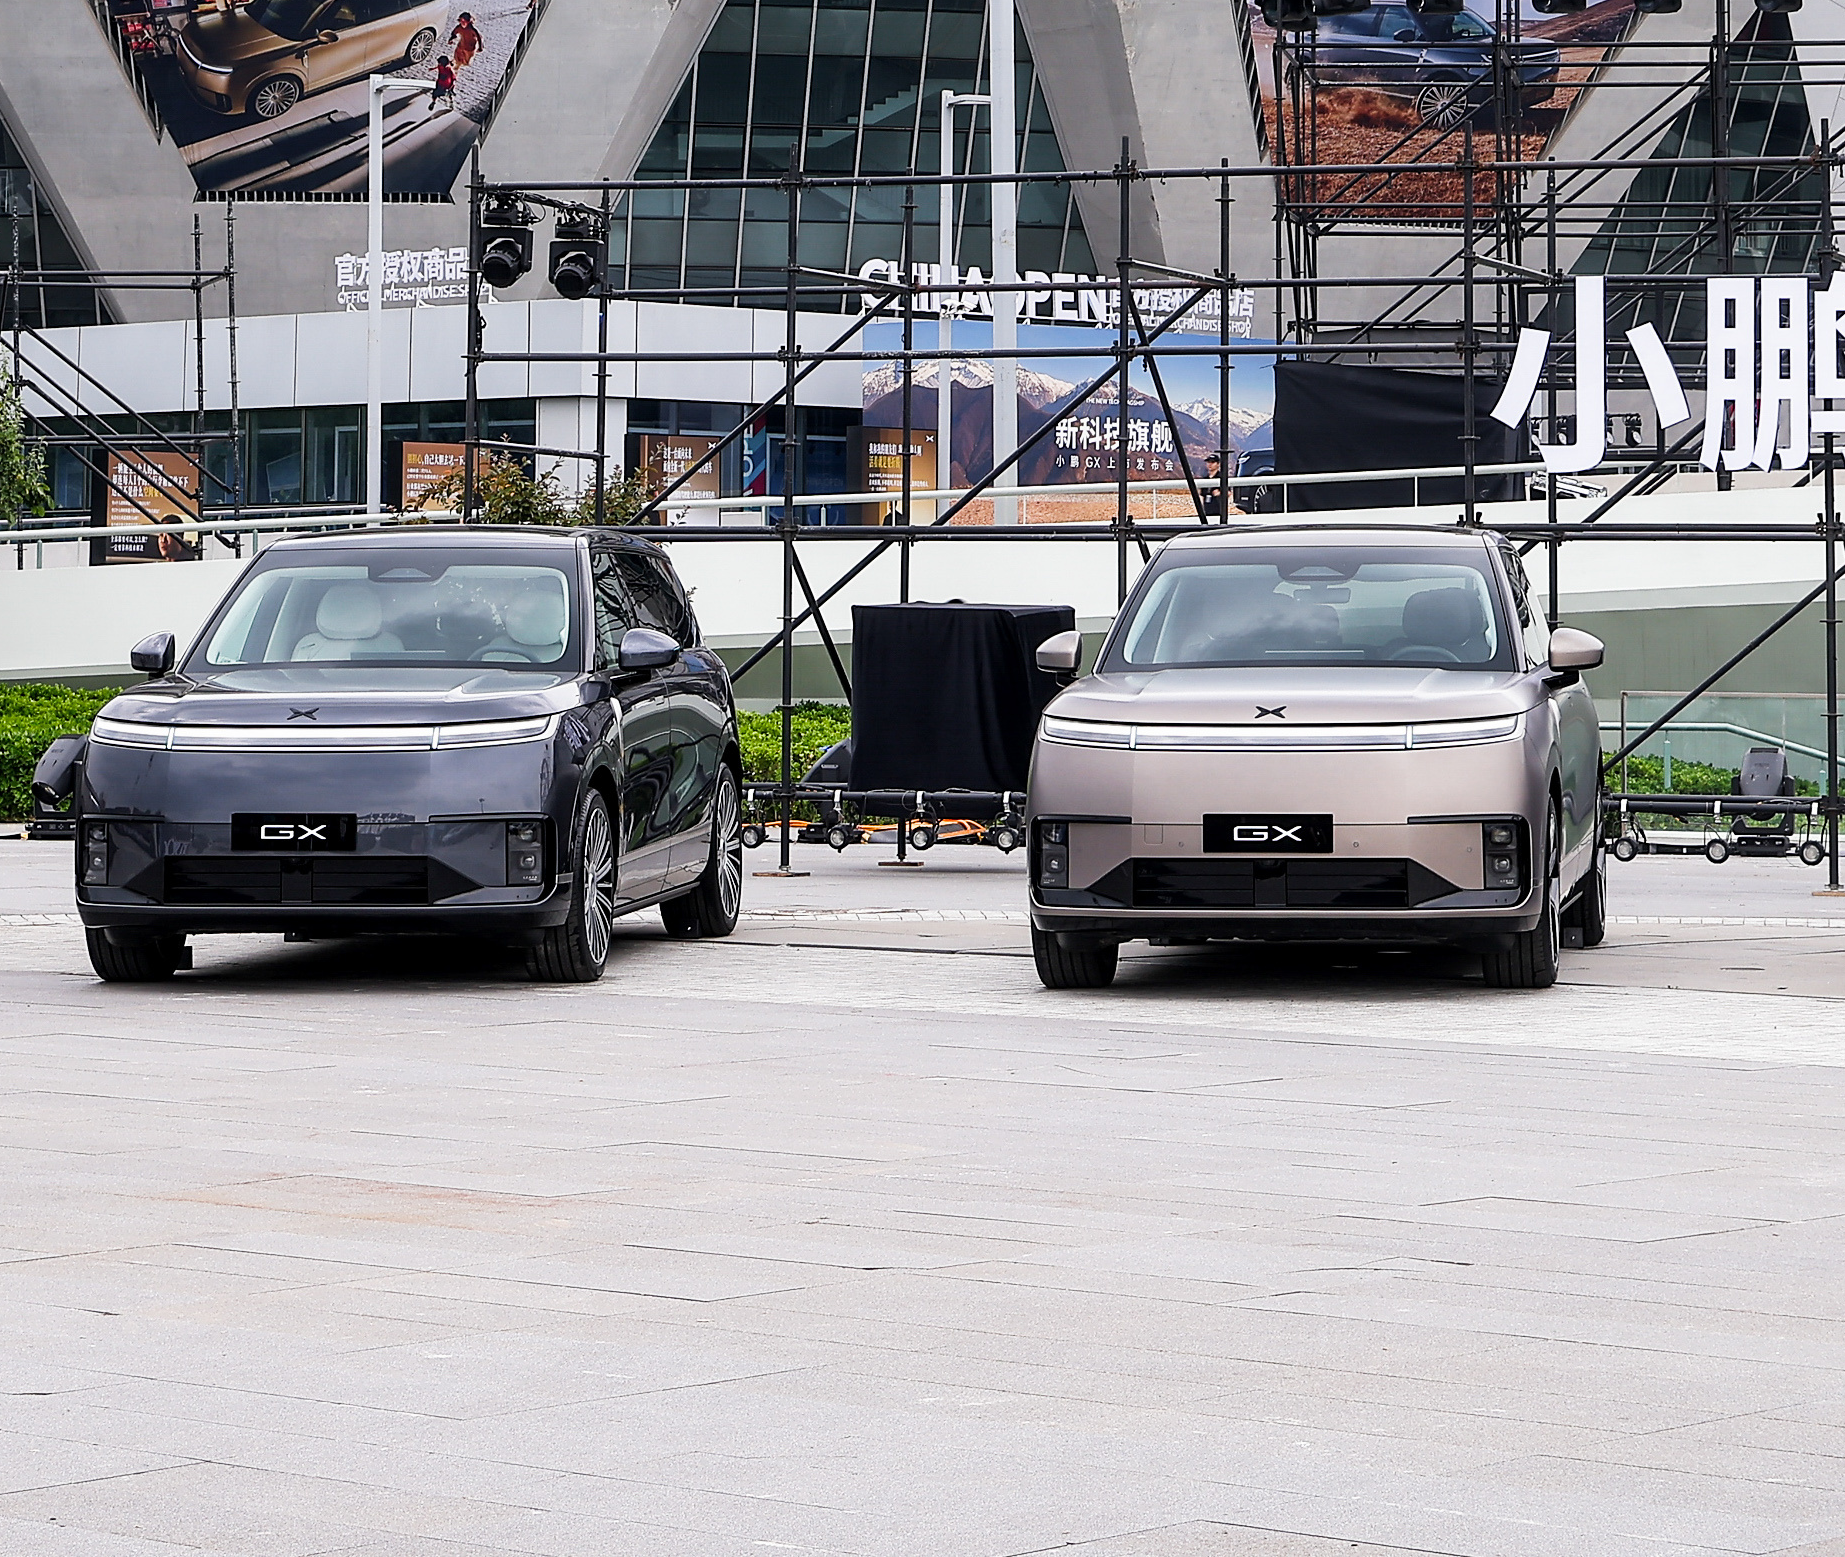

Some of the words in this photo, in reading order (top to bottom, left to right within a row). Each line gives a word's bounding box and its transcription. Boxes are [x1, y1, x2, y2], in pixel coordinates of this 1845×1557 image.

[335, 247, 482, 287] 官方授权商品
[384, 284, 459, 302] MERCHANDISE
[1055, 416, 1174, 453] 新科技旗舰
[260, 824, 327, 840] GX
[1233, 825, 1302, 842] GX
